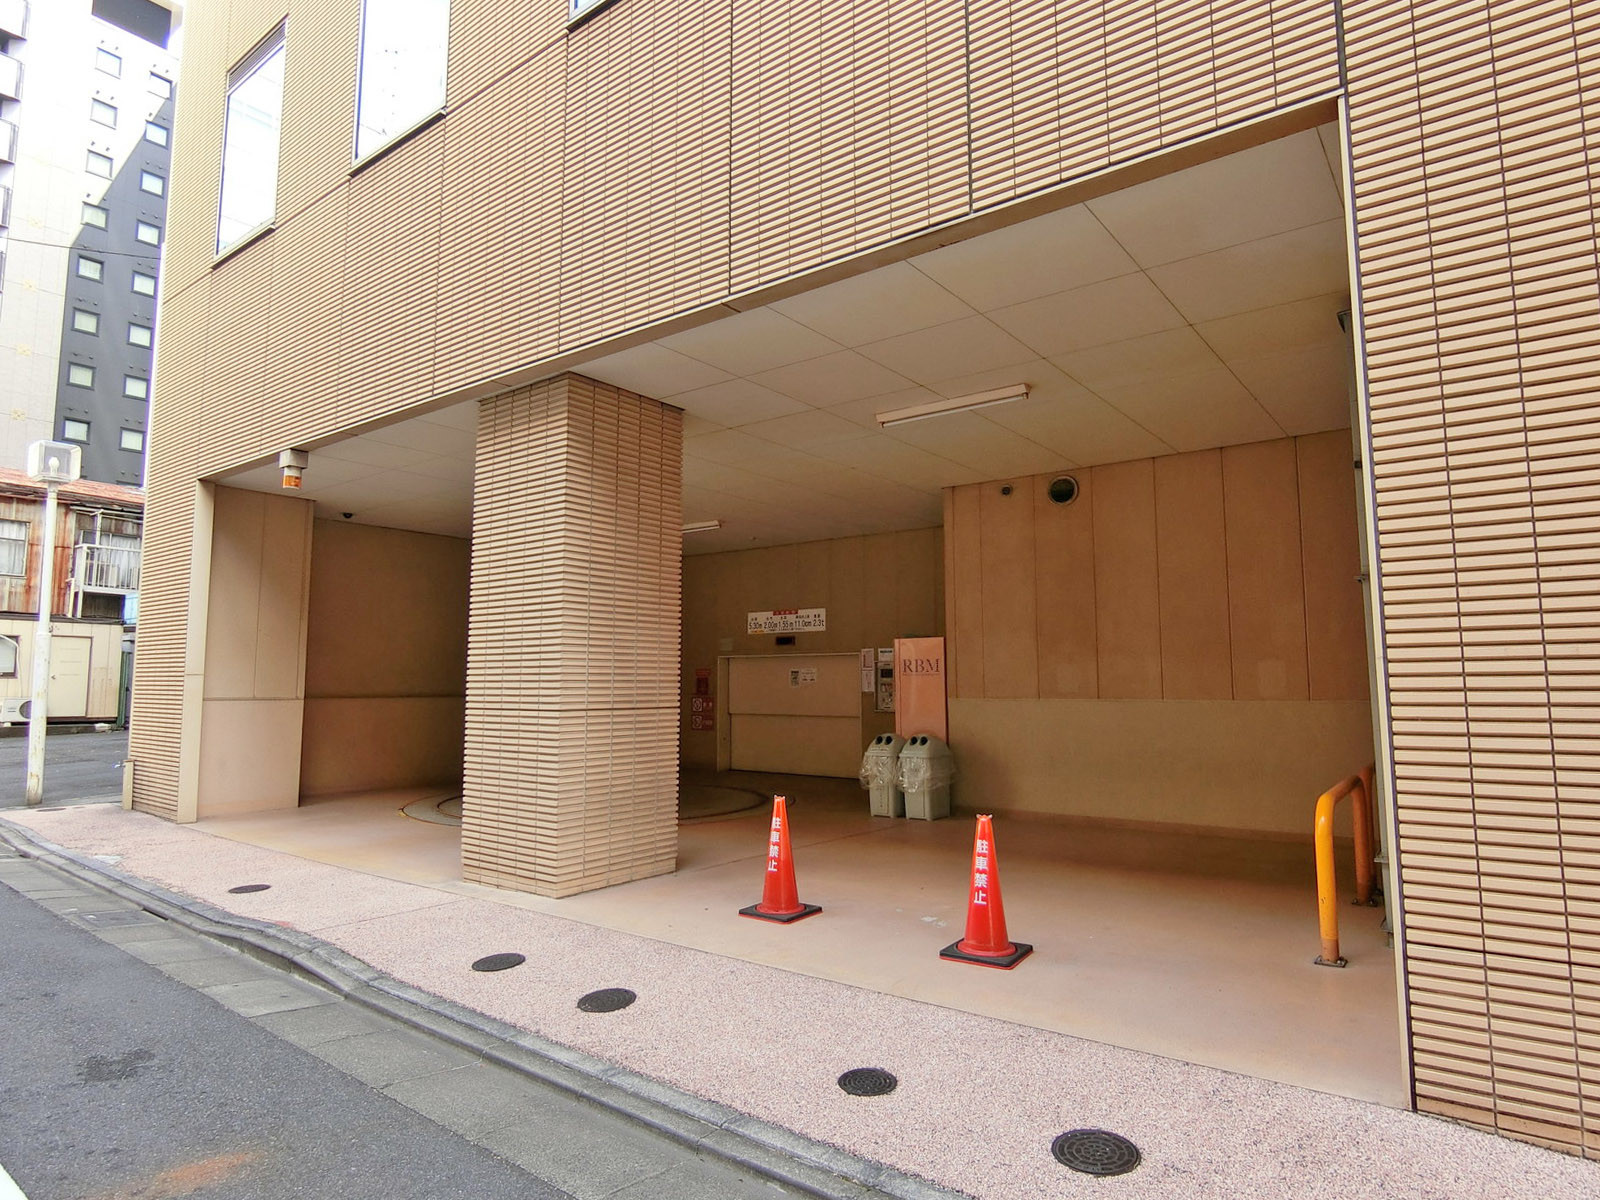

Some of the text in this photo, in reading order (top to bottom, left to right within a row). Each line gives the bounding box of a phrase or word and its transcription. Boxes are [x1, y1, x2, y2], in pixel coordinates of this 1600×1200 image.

[813, 618, 824, 627] 2.3t
[902, 658, 940, 673] RBM
[767, 817, 781, 872] 駐車禁止
[973, 839, 989, 905] 駐車禁止
